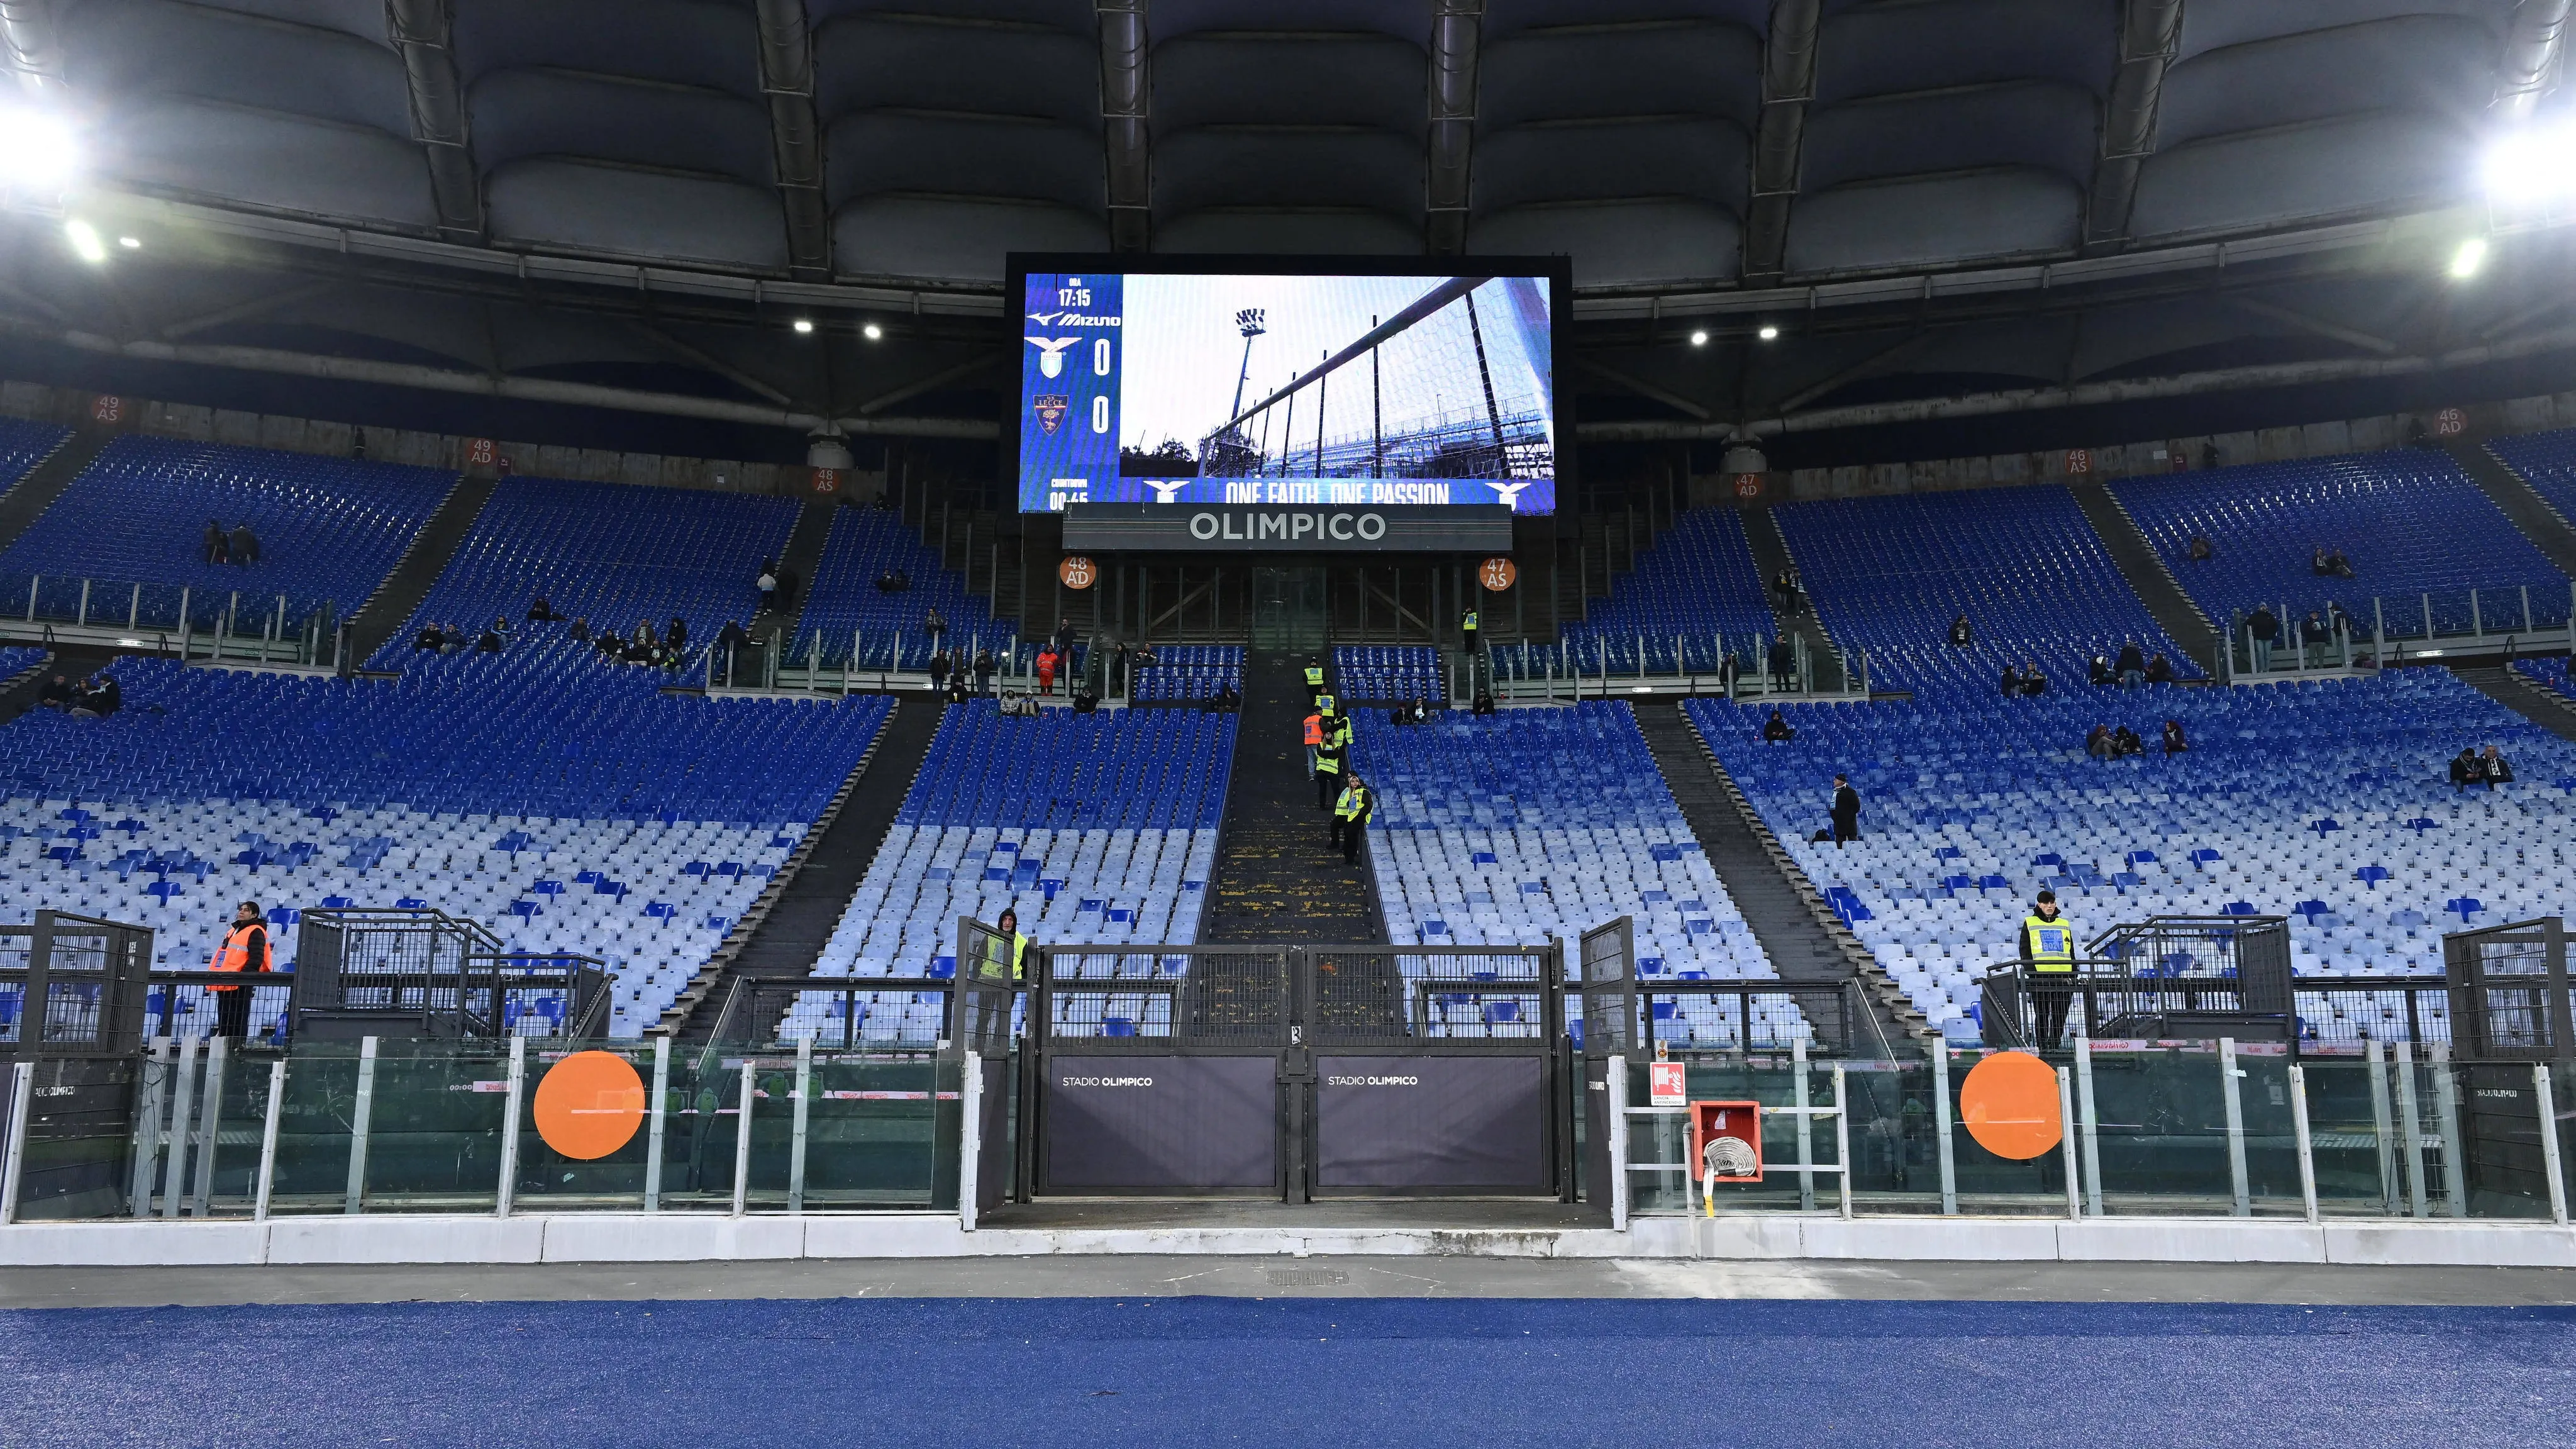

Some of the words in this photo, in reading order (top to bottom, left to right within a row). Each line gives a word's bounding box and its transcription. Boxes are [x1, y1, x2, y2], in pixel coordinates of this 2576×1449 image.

[1069, 277, 1082, 287] ORA
[1058, 289, 1091, 306] 17:15
[1094, 338, 1110, 376] 0
[99, 396, 119, 408] 49
[97, 409, 118, 421] AS
[1092, 395, 1108, 434] 0
[2440, 409, 2458, 421] 46
[2440, 421, 2462, 434] AD
[474, 440, 491, 452] 49
[471, 452, 491, 463] AD
[2070, 450, 2085, 461] 46
[2070, 462, 2087, 473] AS
[818, 470, 833, 480] 48
[1740, 474, 1755, 485] 47
[817, 480, 833, 491] AS
[1051, 478, 1087, 487] COUNTDOWN
[1226, 482, 1262, 504] ONE
[1268, 482, 1318, 504] FAITH
[1330, 483, 1367, 504] ONE
[1372, 483, 1449, 504] PASSION
[1740, 486, 1757, 496] AD
[1189, 513, 1386, 540] OLIMPICO
[1069, 557, 1087, 570] 48
[1487, 558, 1506, 572] 47
[1066, 571, 1089, 584] AD
[1487, 573, 1507, 587] AS
[1062, 1077, 1099, 1086] STADIO
[1102, 1077, 1153, 1086] OLIMPICO
[1328, 1076, 1365, 1085] STADIO
[1367, 1076, 1418, 1085] OLIMPICO
